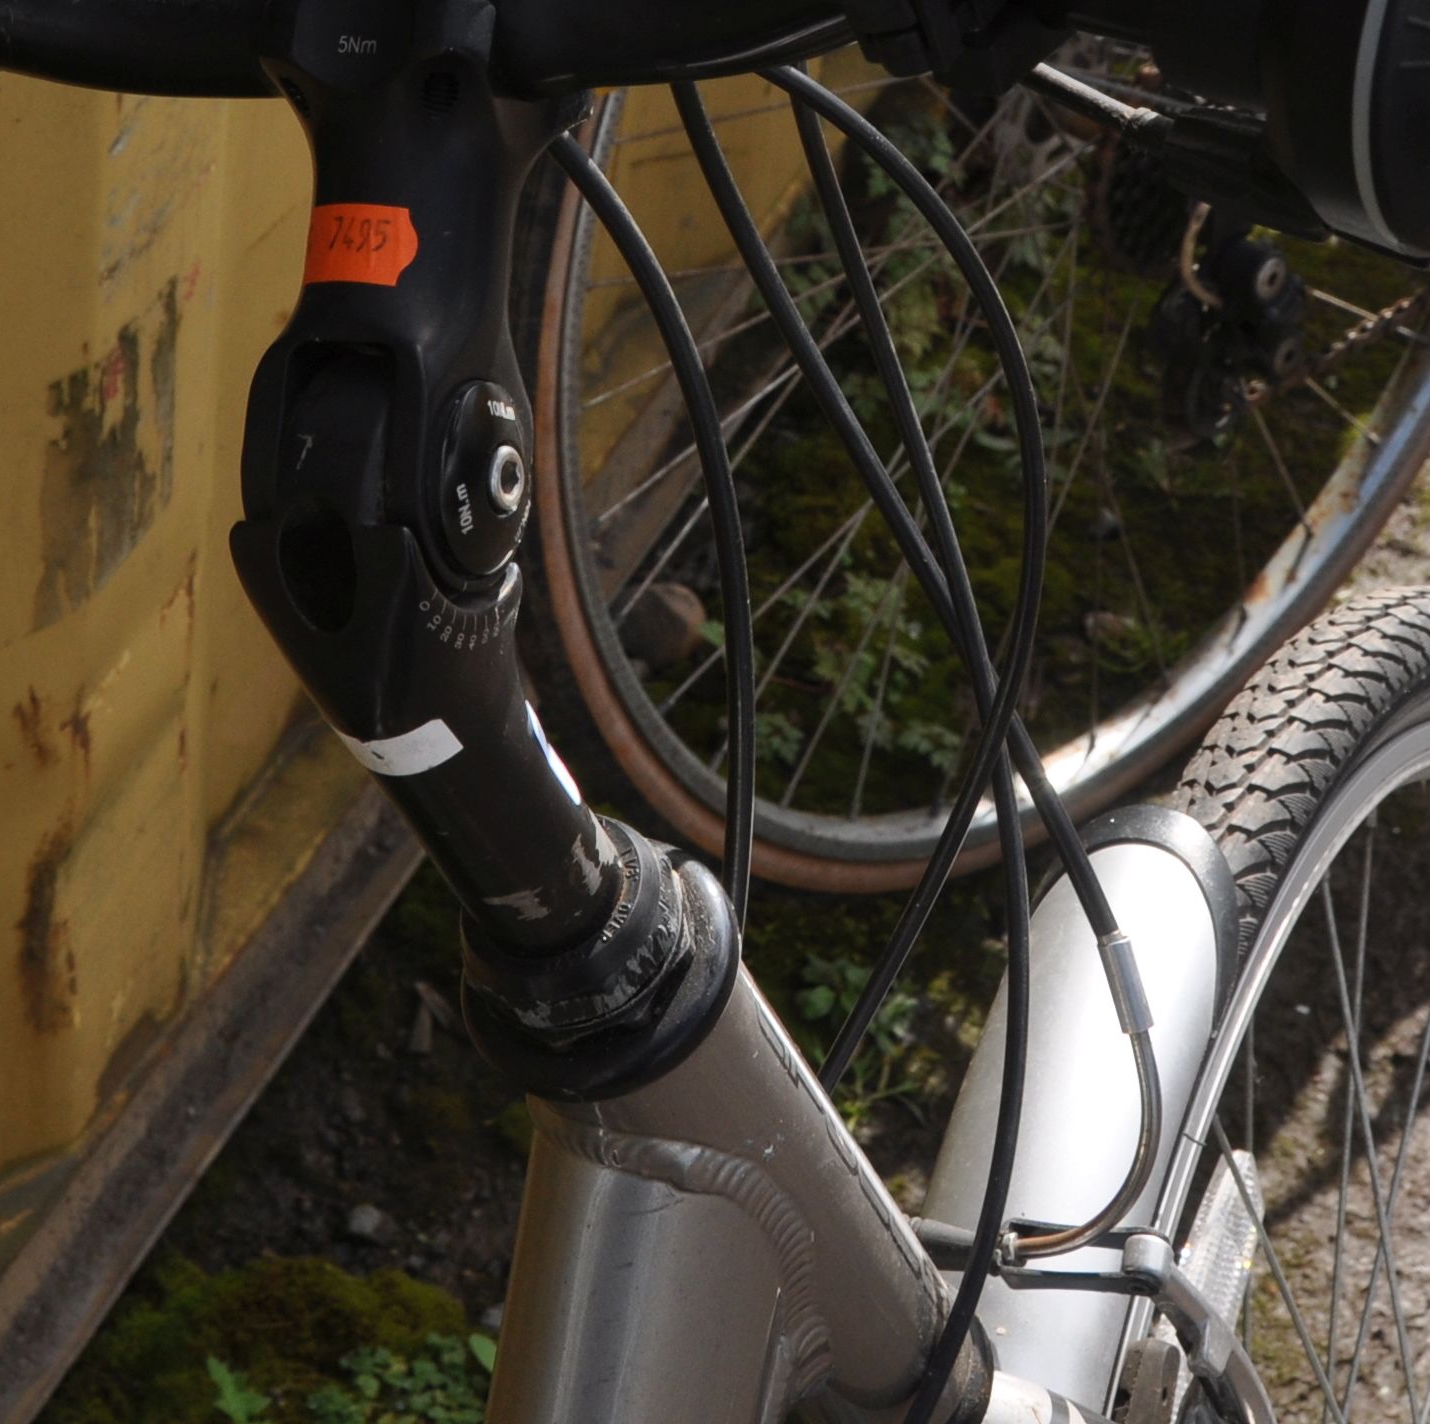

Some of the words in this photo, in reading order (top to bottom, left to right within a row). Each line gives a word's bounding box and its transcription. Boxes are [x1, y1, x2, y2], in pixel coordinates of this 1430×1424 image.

[338, 35, 377, 54] 5Nm
[328, 215, 391, 253] 7495
[456, 483, 475, 536] 10N.m
[418, 600, 431, 612] 0
[426, 614, 442, 631] 10
[439, 625, 453, 643] 20
